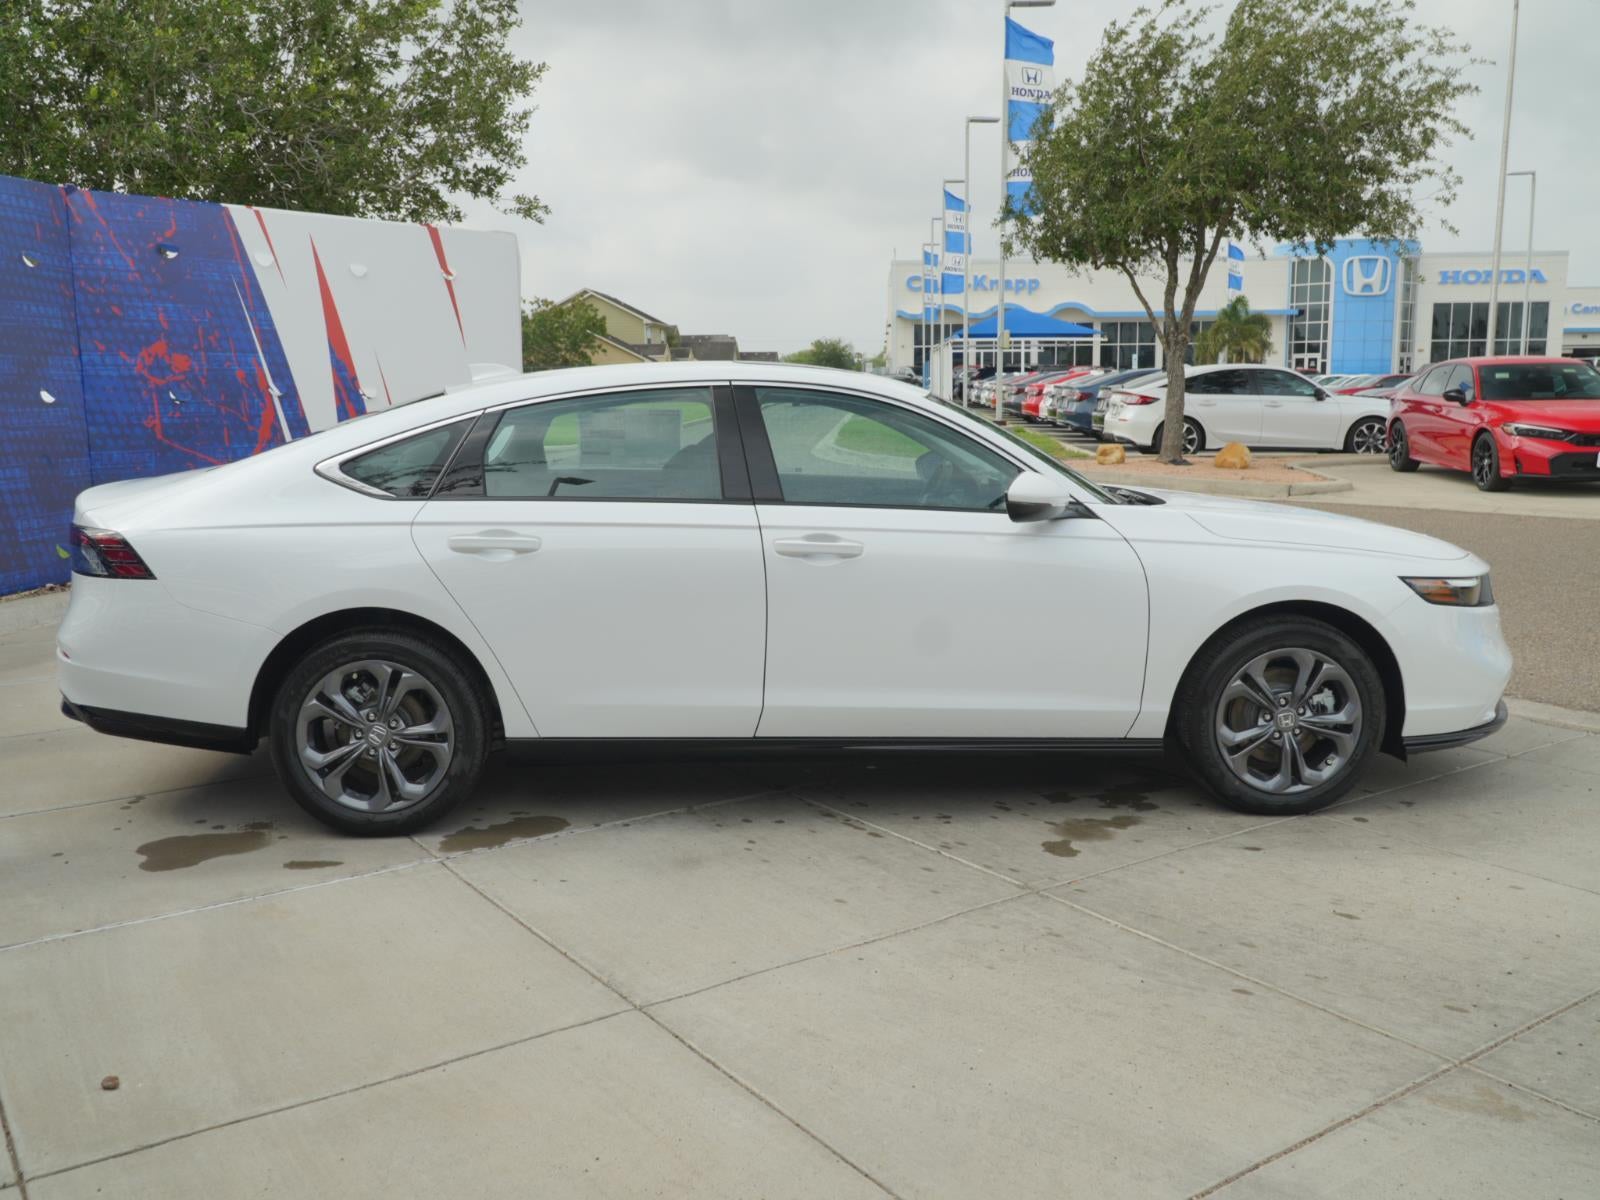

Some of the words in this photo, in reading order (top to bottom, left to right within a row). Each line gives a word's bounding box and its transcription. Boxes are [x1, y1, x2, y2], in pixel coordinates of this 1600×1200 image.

[1011, 86, 1052, 100] HONDA
[1012, 167, 1032, 177] HON
[1438, 269, 1548, 285] HONDA
